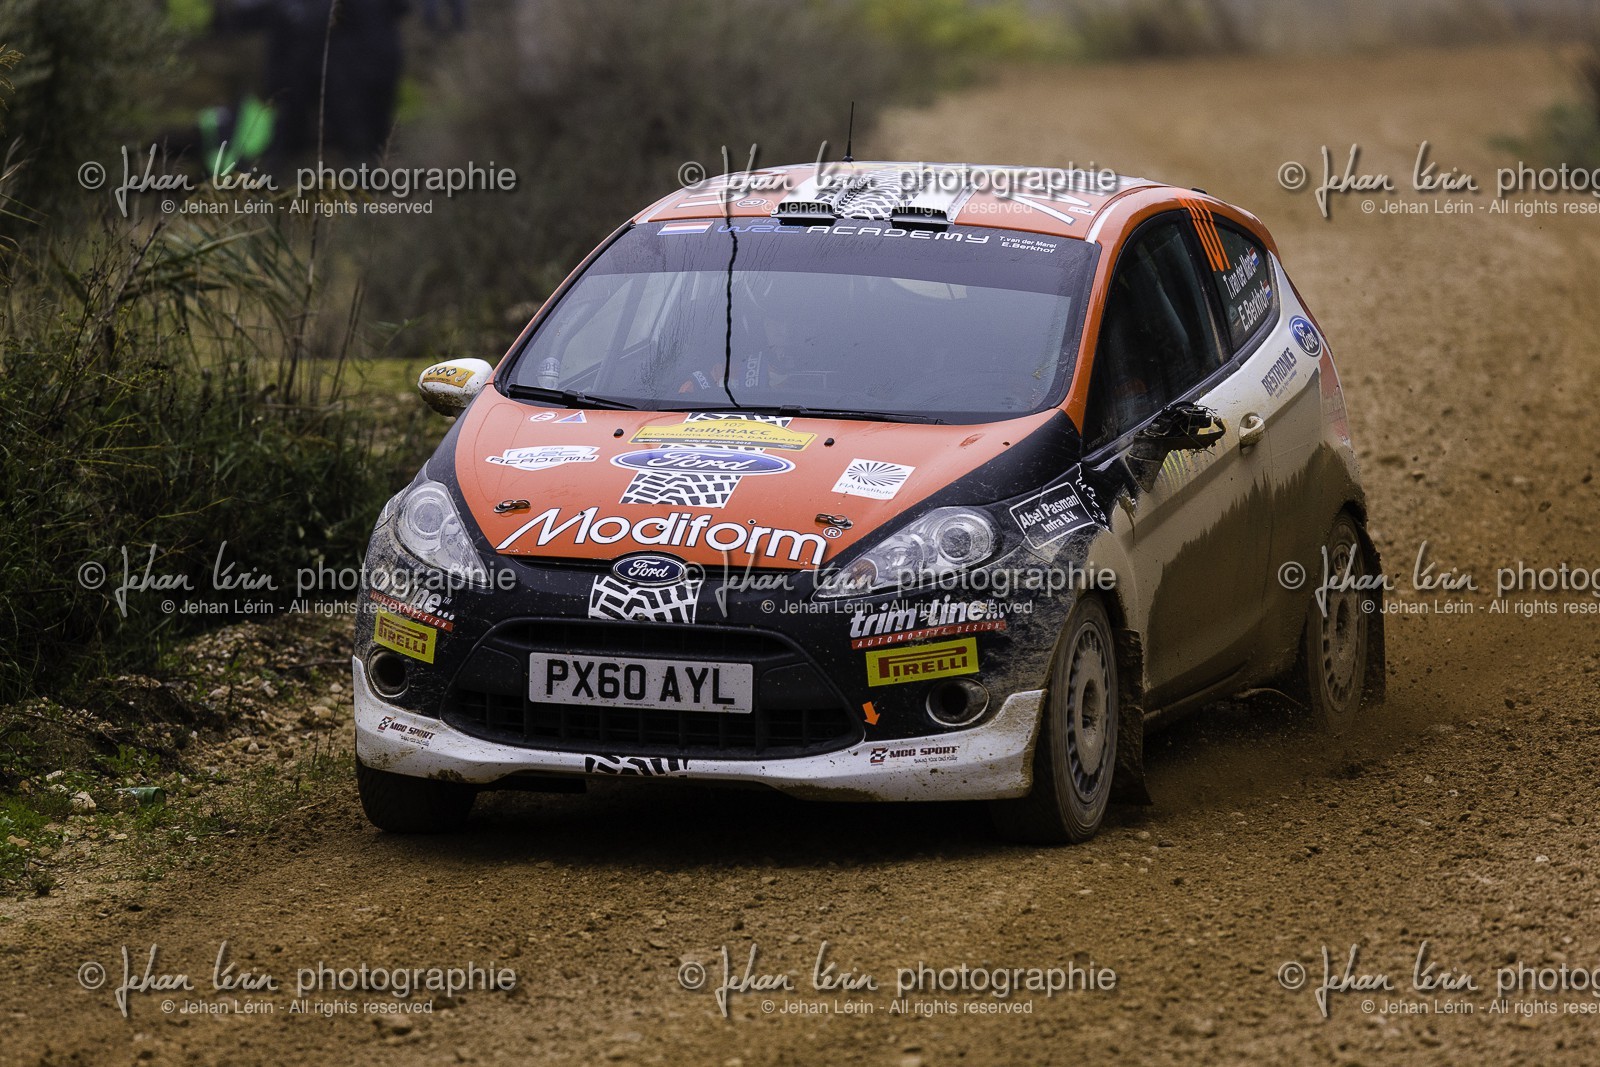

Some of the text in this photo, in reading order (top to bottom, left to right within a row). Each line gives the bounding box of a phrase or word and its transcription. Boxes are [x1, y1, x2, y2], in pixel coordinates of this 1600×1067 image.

[806, 225, 989, 244] ACADEMY
[1294, 322, 1319, 351] Ford
[1261, 347, 1298, 397] BESTRONICS
[683, 427, 772, 437] RallyRACC
[747, 435, 803, 443] DAURADA
[490, 456, 596, 465] ACADEMY
[647, 452, 757, 470] Ford
[856, 485, 893, 495] Institute
[1019, 494, 1080, 529] Abel Pasman
[1041, 513, 1064, 533] Infra
[627, 559, 670, 577] Ford
[379, 617, 428, 655] PIRELLI
[957, 622, 1001, 633] DESIGN
[878, 646, 968, 679] PIRELLI
[546, 659, 735, 704] PX60 AYL
[408, 727, 435, 740] SPORT
[920, 745, 960, 756] SPORT
